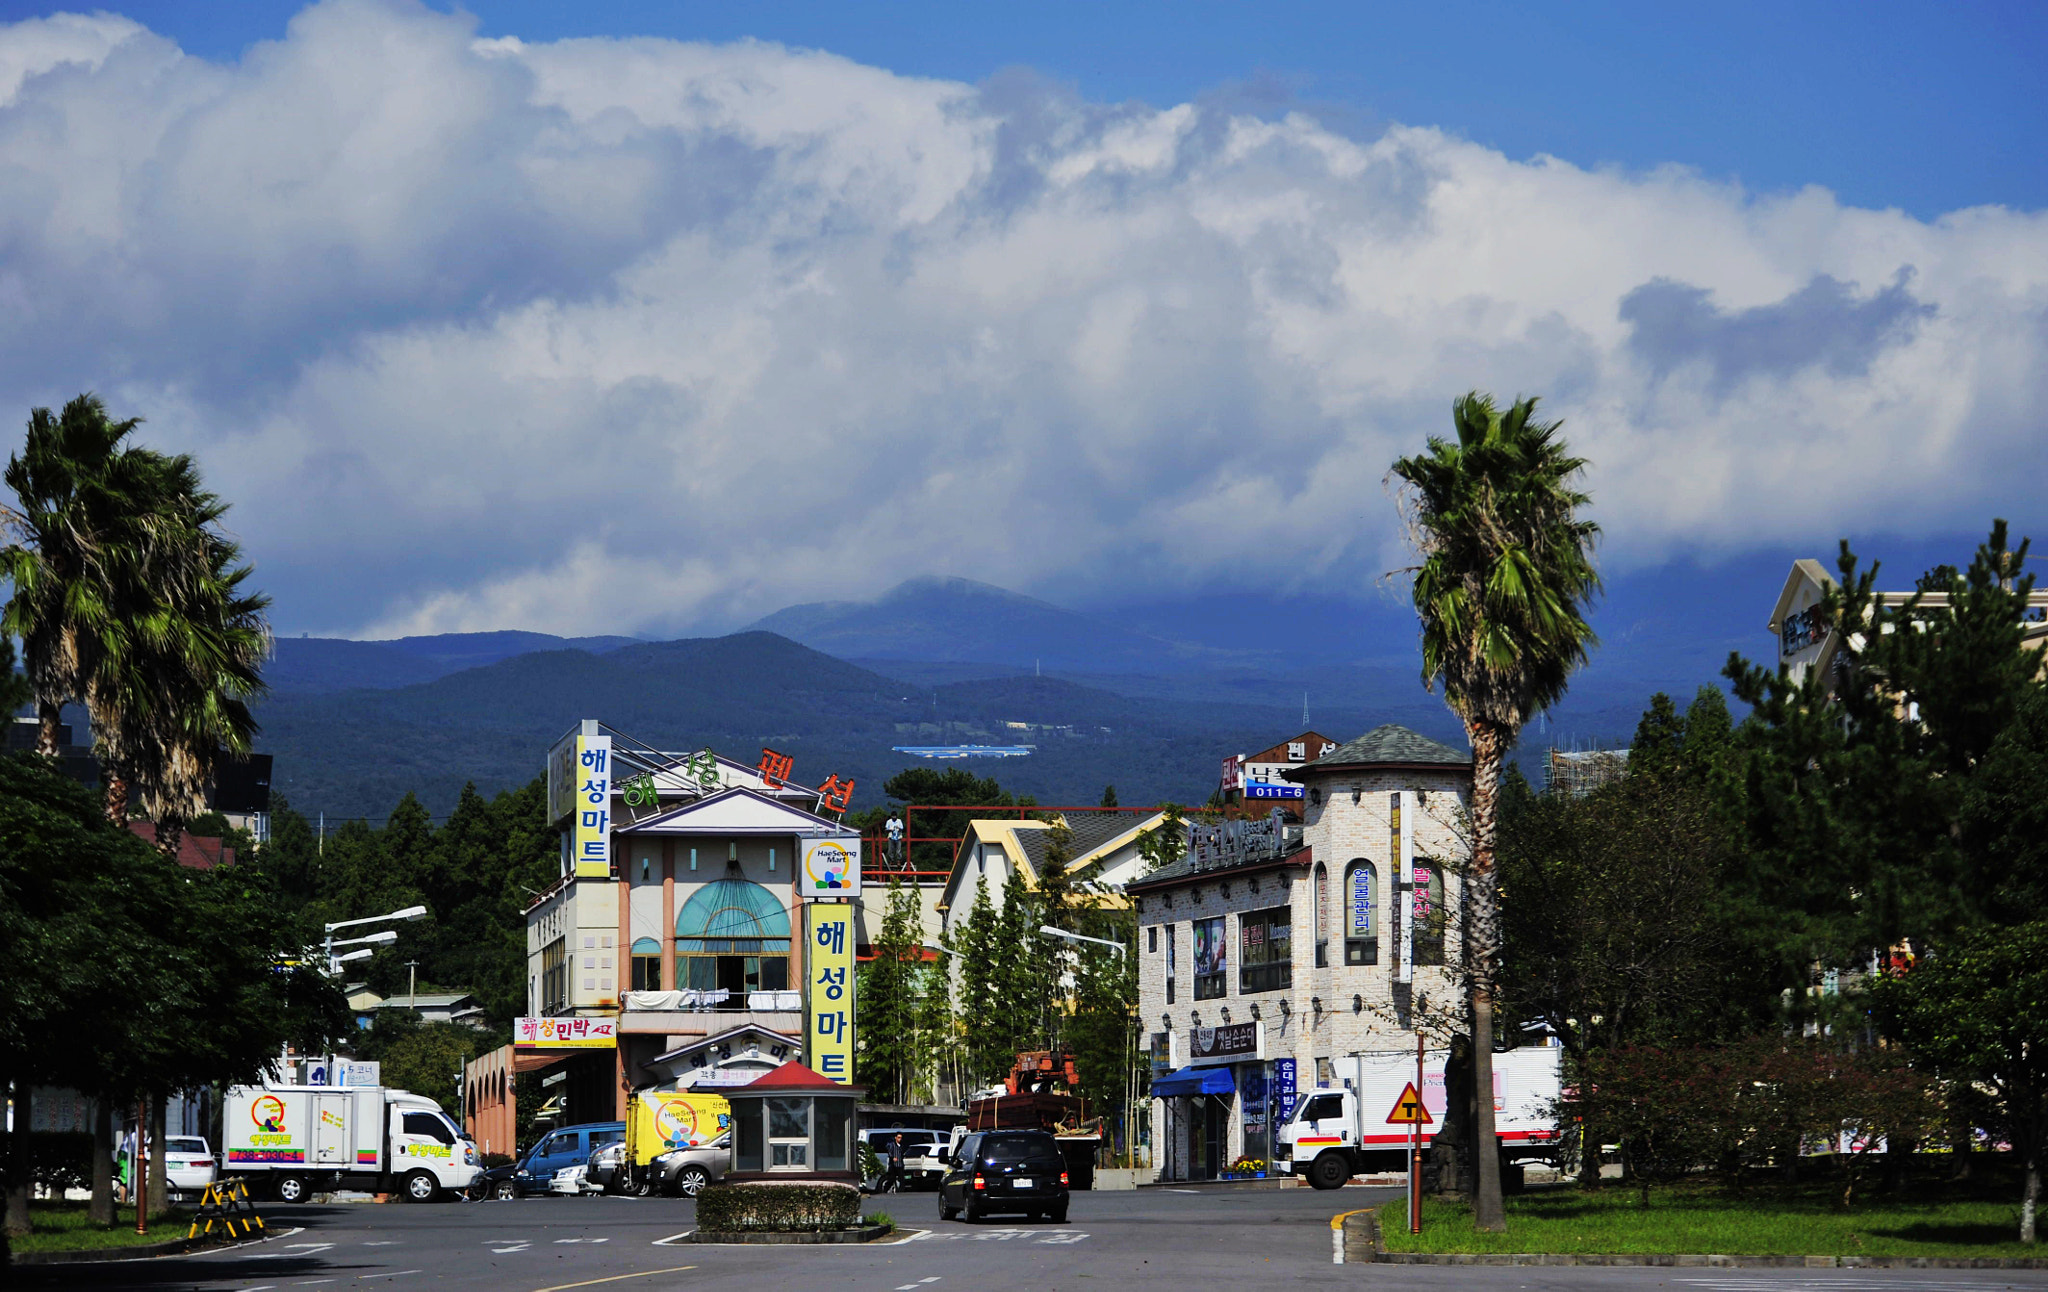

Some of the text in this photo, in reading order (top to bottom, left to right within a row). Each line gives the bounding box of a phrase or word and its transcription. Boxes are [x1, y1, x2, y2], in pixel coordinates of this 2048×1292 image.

[1256, 788, 1302, 797] 011-6
[580, 749, 609, 862] 해성마트
[817, 850, 857, 858] HaeSeong
[1413, 867, 1431, 883] 발
[1353, 868, 1370, 929] 얼굴관리
[816, 921, 848, 1082] 해성마트
[521, 1018, 591, 1041] 해성민박
[1217, 1026, 1255, 1051] 옛날손순대
[664, 1108, 707, 1119] HaeSeong
[676, 1115, 697, 1124] Mart
[249, 1134, 292, 1147] 해성마트
[407, 1143, 452, 1159] 해성마트
